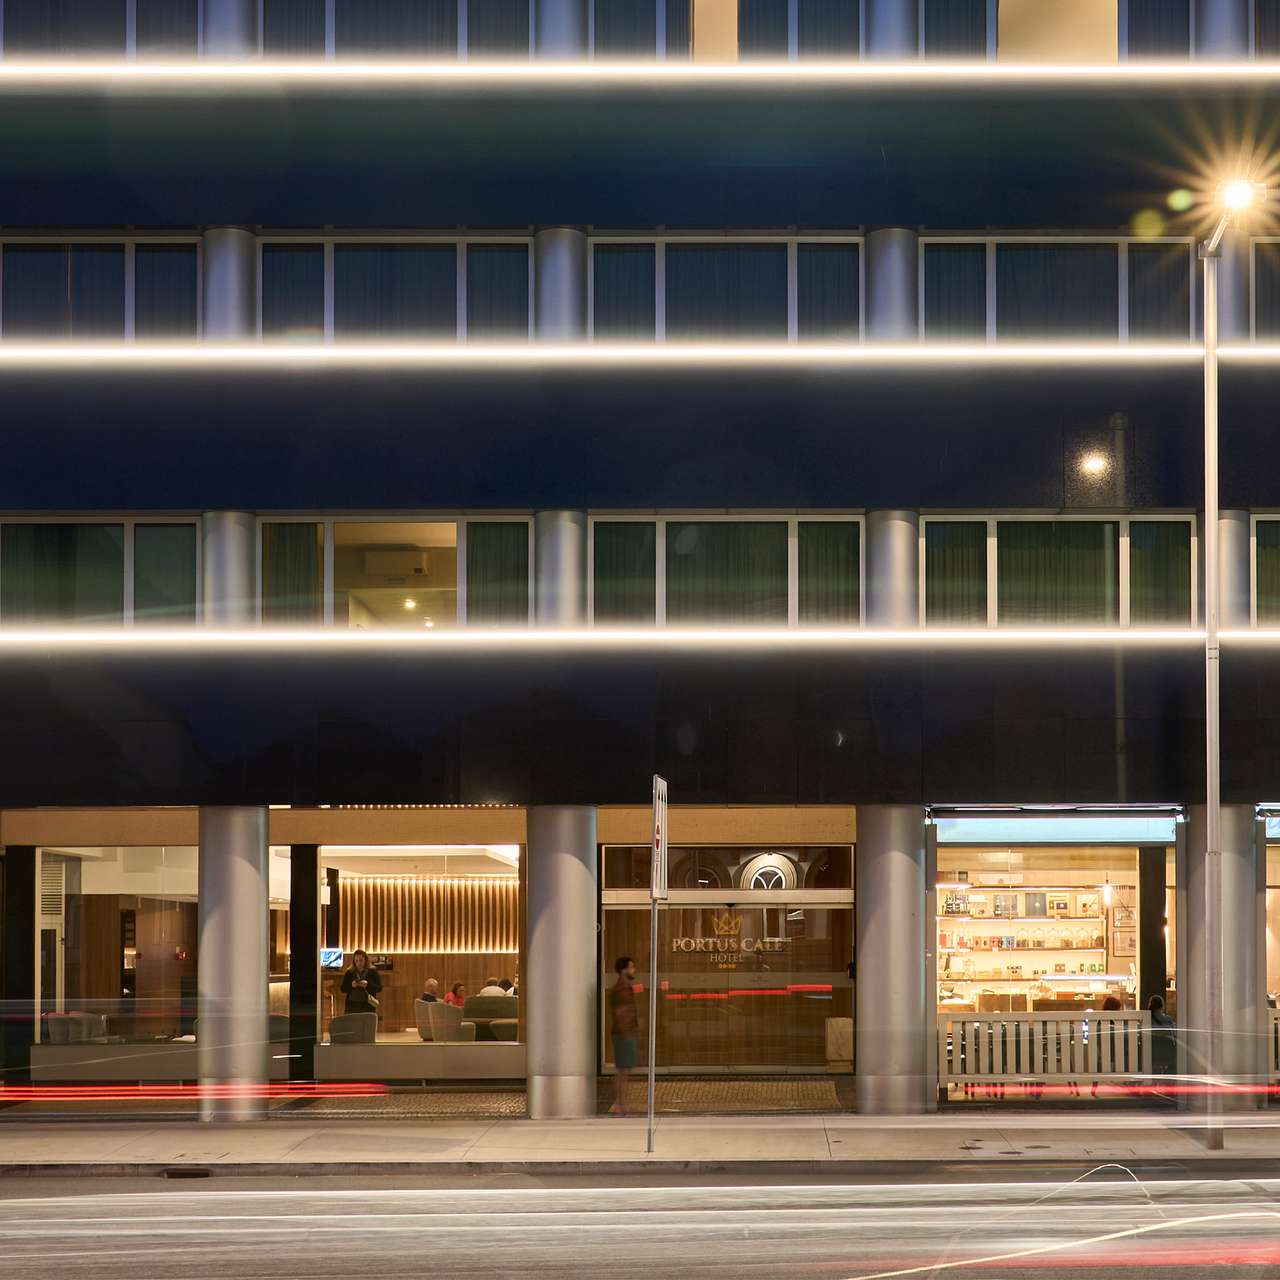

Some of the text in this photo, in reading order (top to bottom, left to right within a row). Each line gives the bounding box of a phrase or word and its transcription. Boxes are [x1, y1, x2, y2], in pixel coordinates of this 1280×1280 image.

[671, 937, 783, 952] PORTUS CALE
[709, 953, 744, 962] HOTEL
